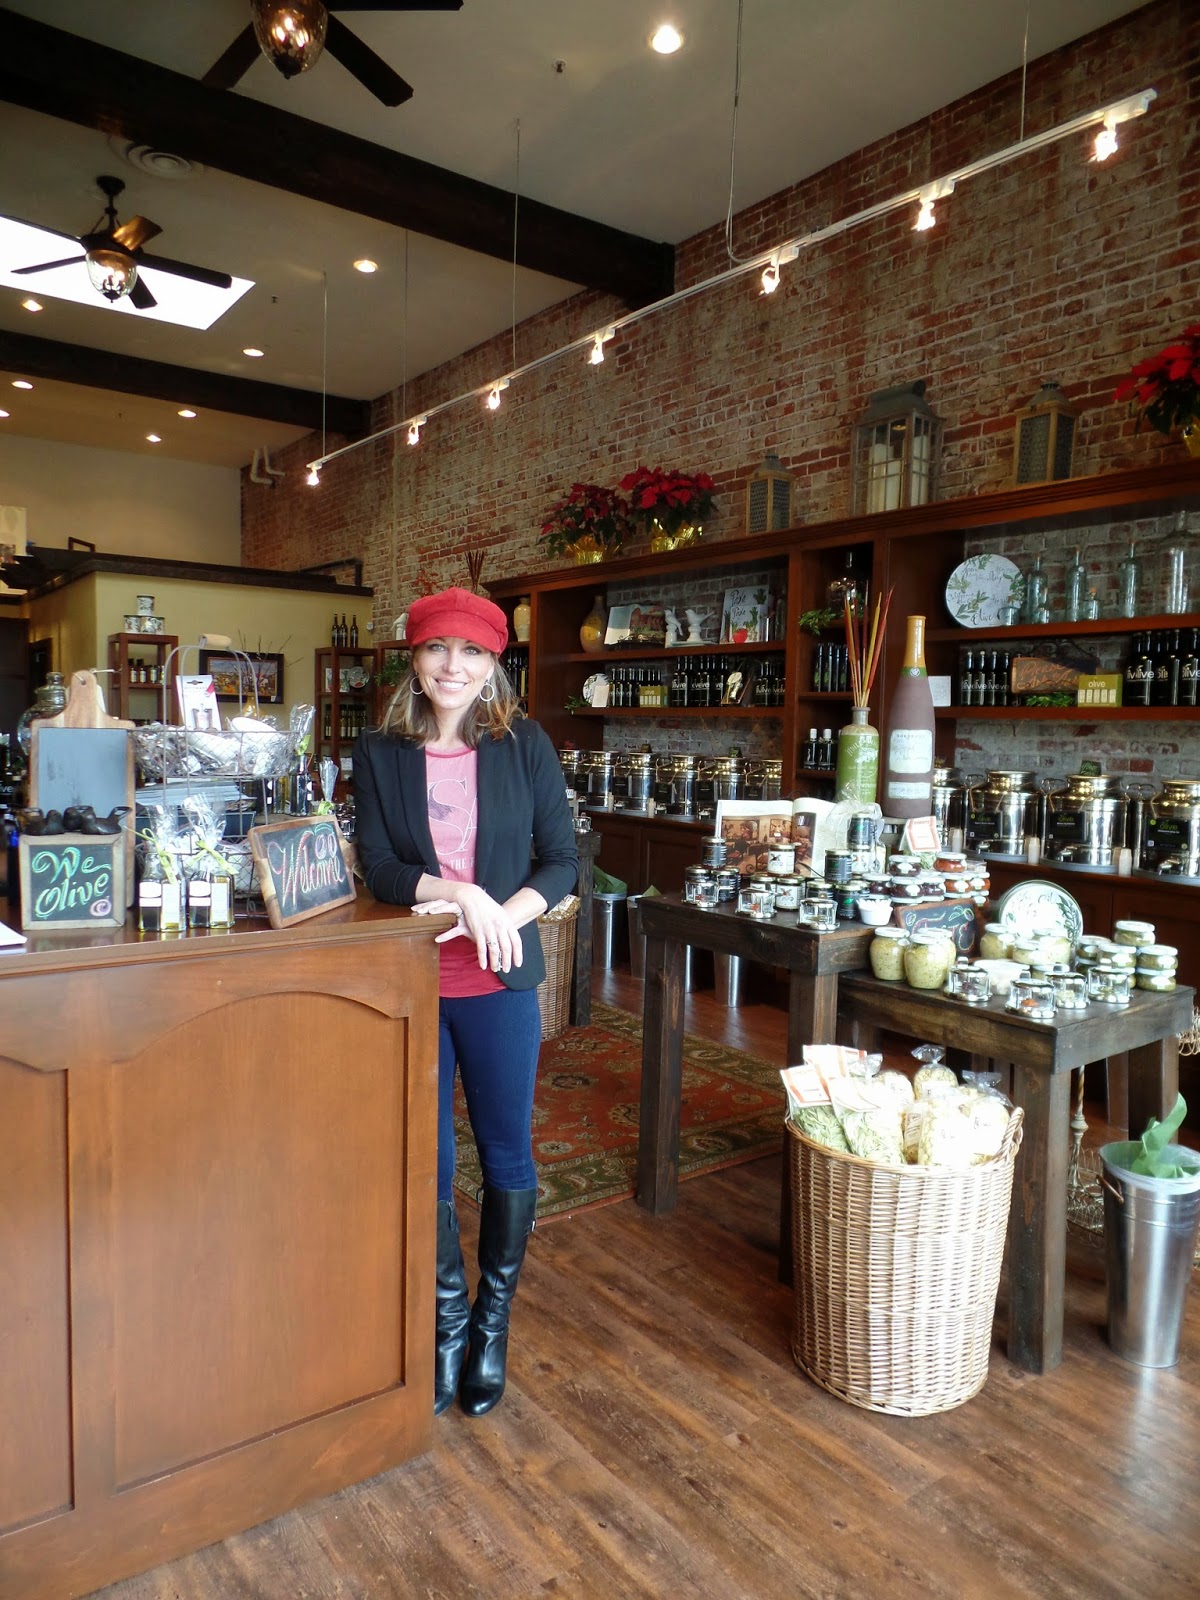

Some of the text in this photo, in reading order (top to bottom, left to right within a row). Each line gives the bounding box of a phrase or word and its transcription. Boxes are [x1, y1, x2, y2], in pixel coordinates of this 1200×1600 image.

[1088, 679, 1106, 688] olive
[32, 846, 112, 884] We
[268, 830, 345, 908] Welcome
